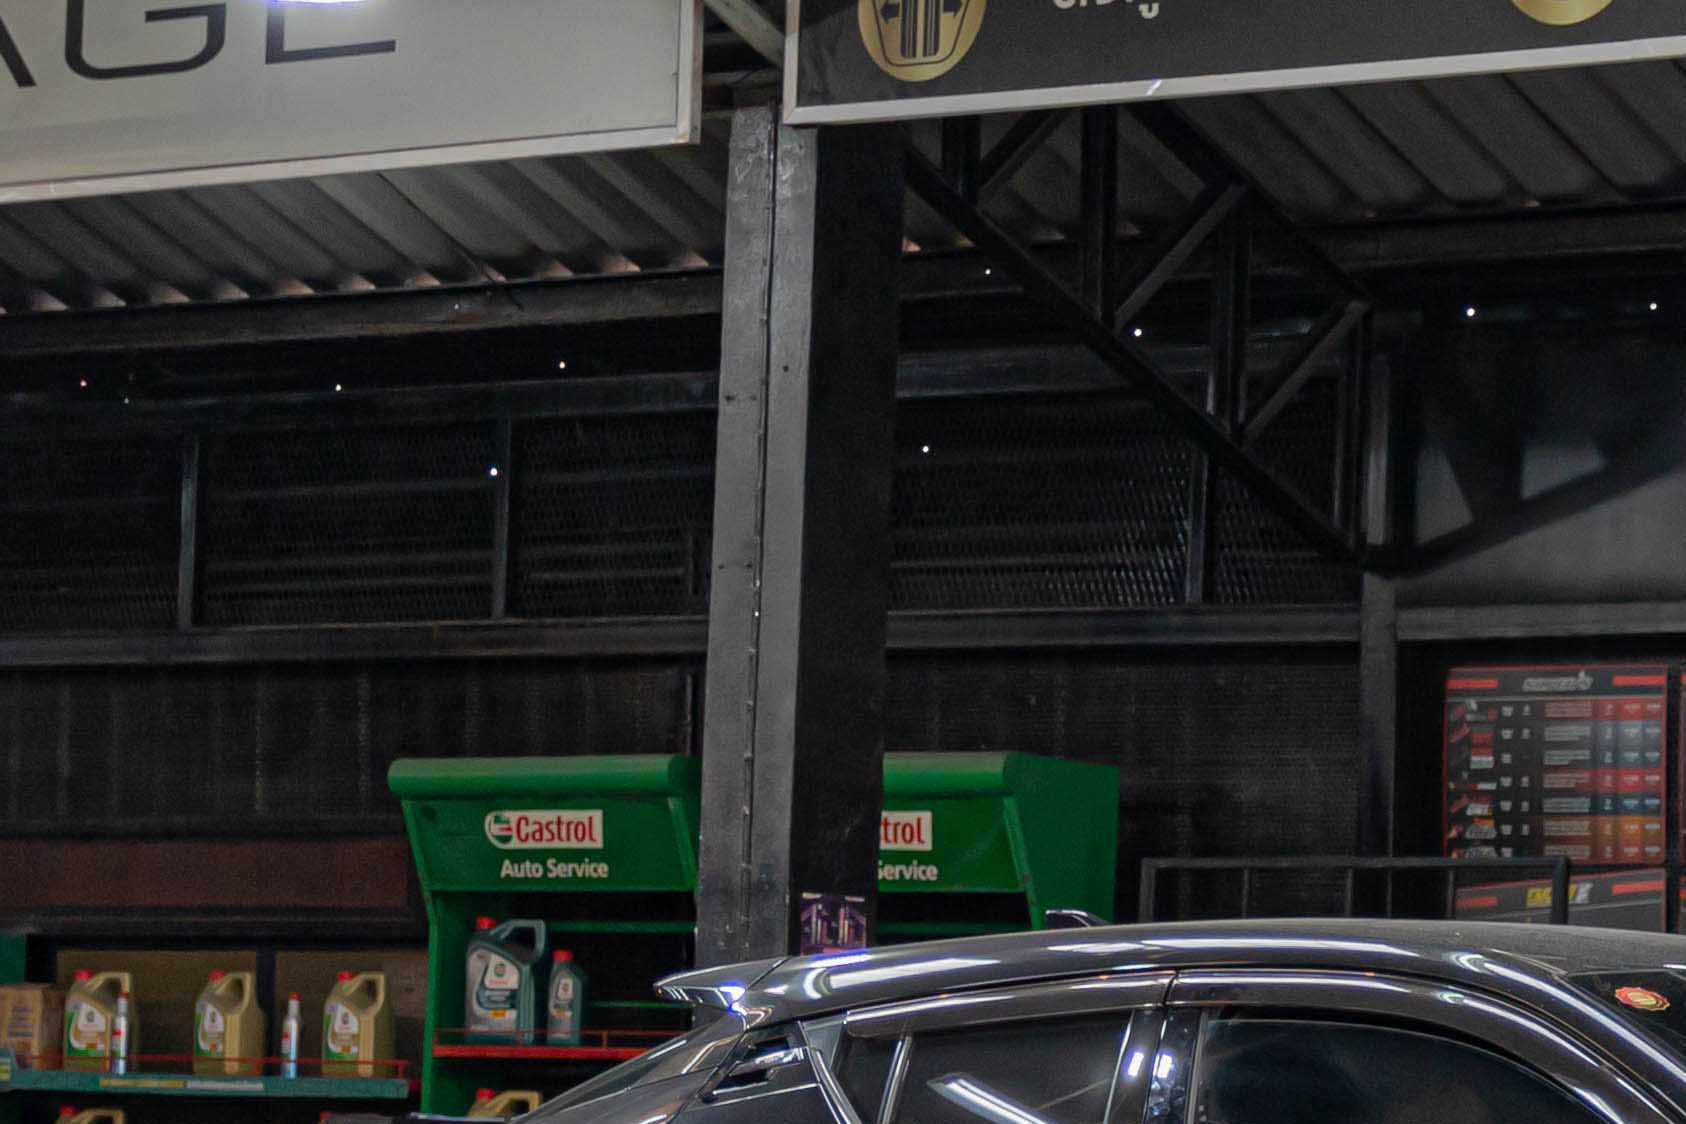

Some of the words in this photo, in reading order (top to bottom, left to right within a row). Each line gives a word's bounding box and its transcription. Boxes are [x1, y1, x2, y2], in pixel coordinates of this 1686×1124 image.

[515, 815, 597, 844] Castrol
[880, 817, 926, 845] trol
[500, 858, 544, 879] Auto
[546, 857, 609, 878] Service
